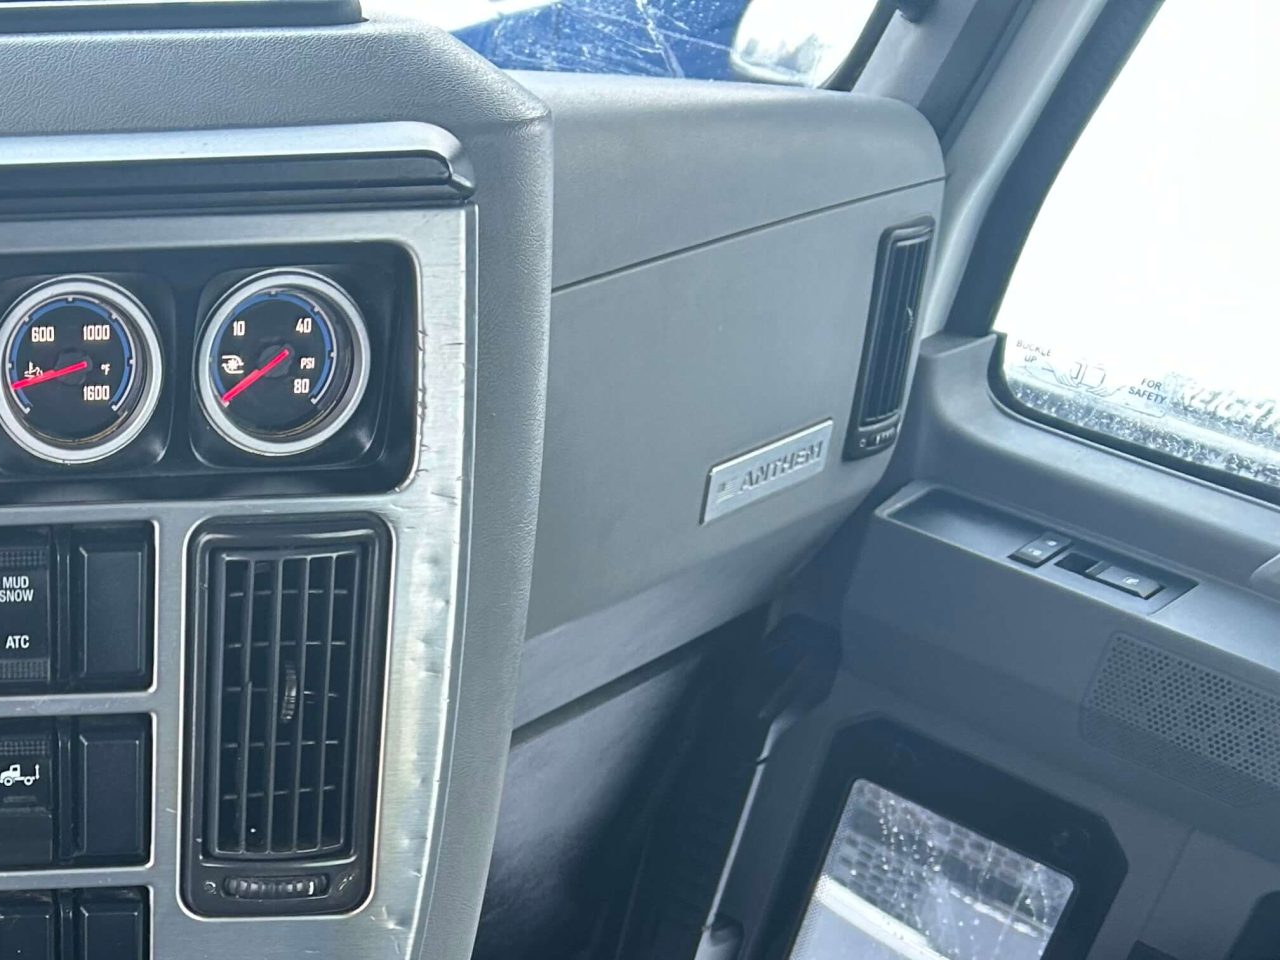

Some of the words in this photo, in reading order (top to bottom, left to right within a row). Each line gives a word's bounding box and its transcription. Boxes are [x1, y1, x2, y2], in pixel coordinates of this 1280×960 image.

[82, 324, 111, 341] 1000
[232, 320, 246, 336] 10
[295, 317, 313, 334] 40
[31, 326, 55, 342] 600
[300, 357, 315, 369] PSI
[1024, 353, 1037, 363] UP
[293, 378, 310, 394] 80
[1141, 377, 1162, 391] FOR
[82, 385, 111, 401] 1600
[1128, 385, 1168, 405] SAFETY
[739, 440, 823, 492] ANTHEM
[2, 575, 29, 589] MUD
[5, 635, 30, 649] ATC
